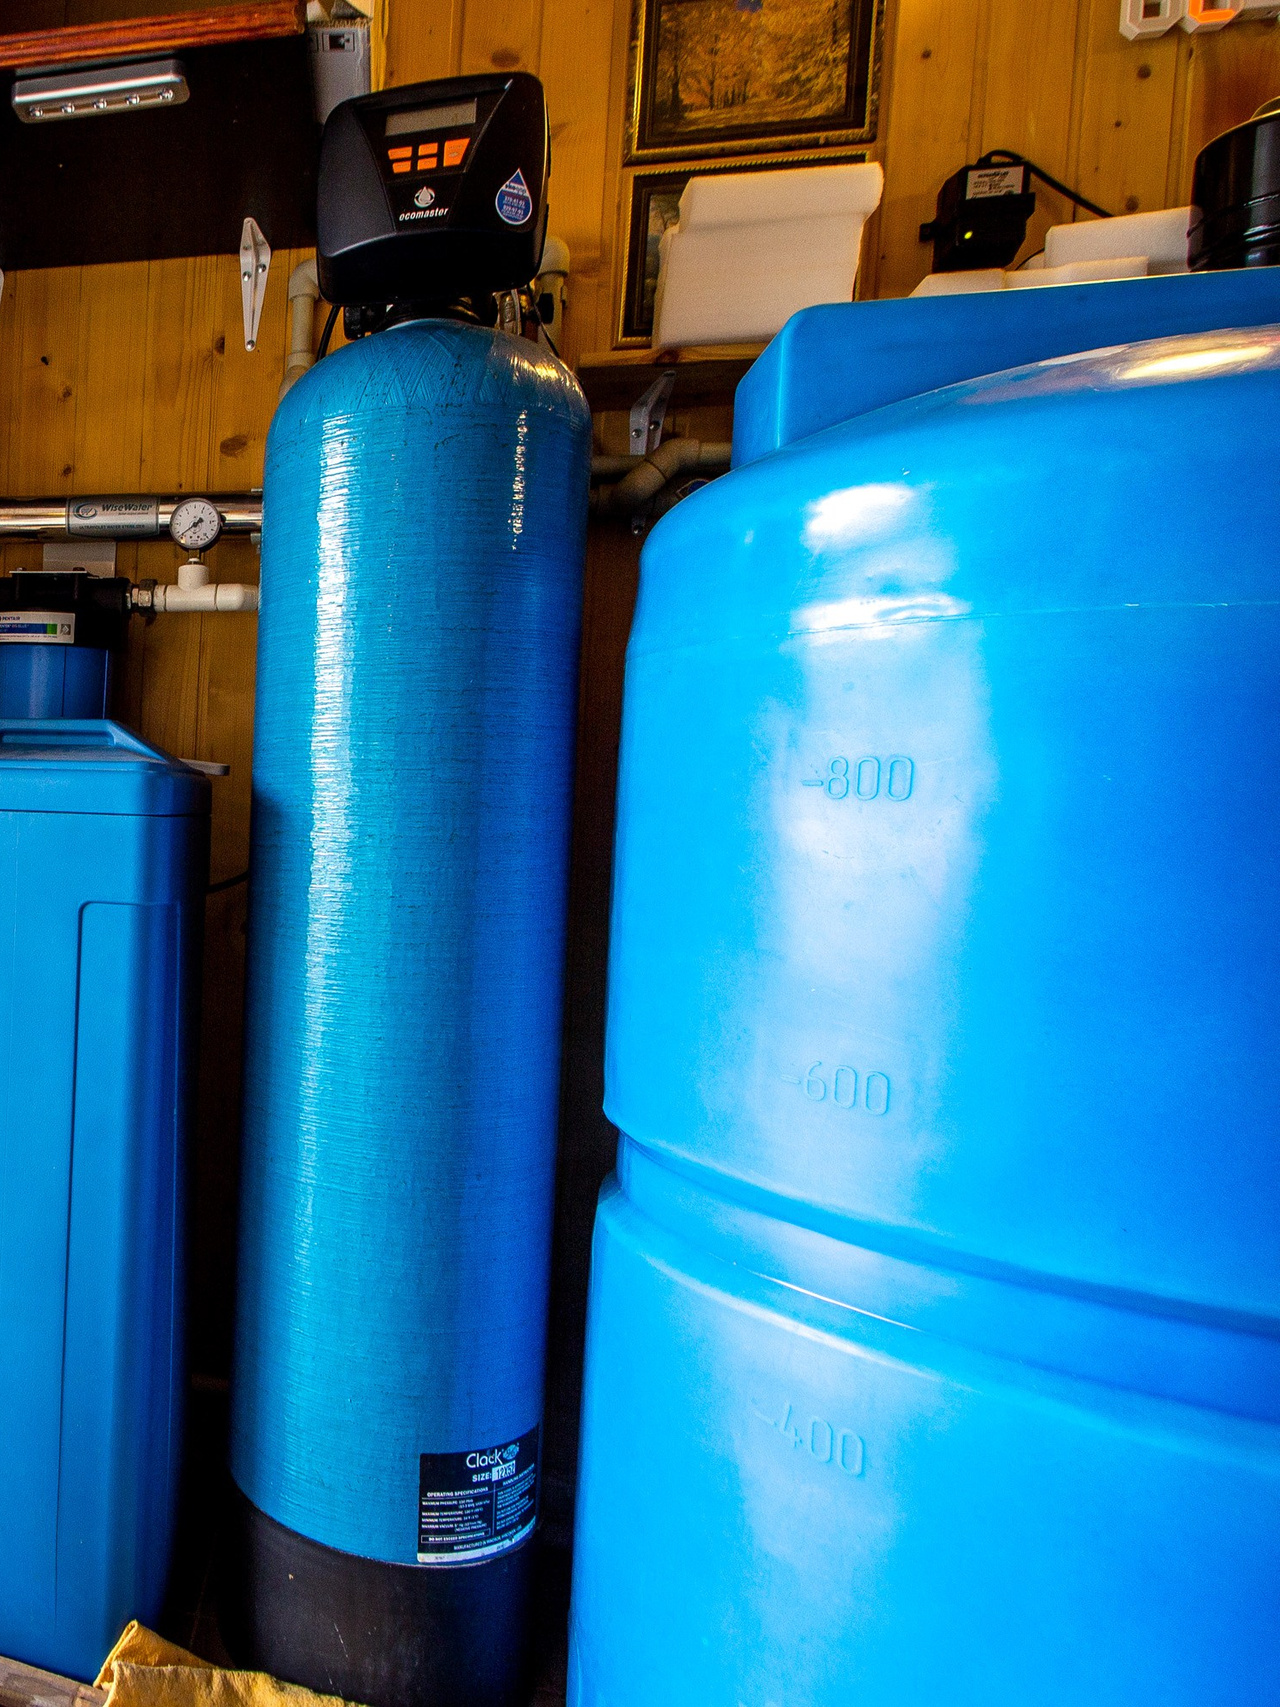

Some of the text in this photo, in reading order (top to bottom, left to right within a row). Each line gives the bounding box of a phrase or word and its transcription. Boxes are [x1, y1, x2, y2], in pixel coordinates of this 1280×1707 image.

[398, 207, 449, 221] ecomaster
[101, 503, 153, 512] WiseWater
[466, 1448, 503, 1469] Clack
[472, 1472, 493, 1483] SIZE:
[454, 1486, 489, 1497] SPECIFICATIONS
